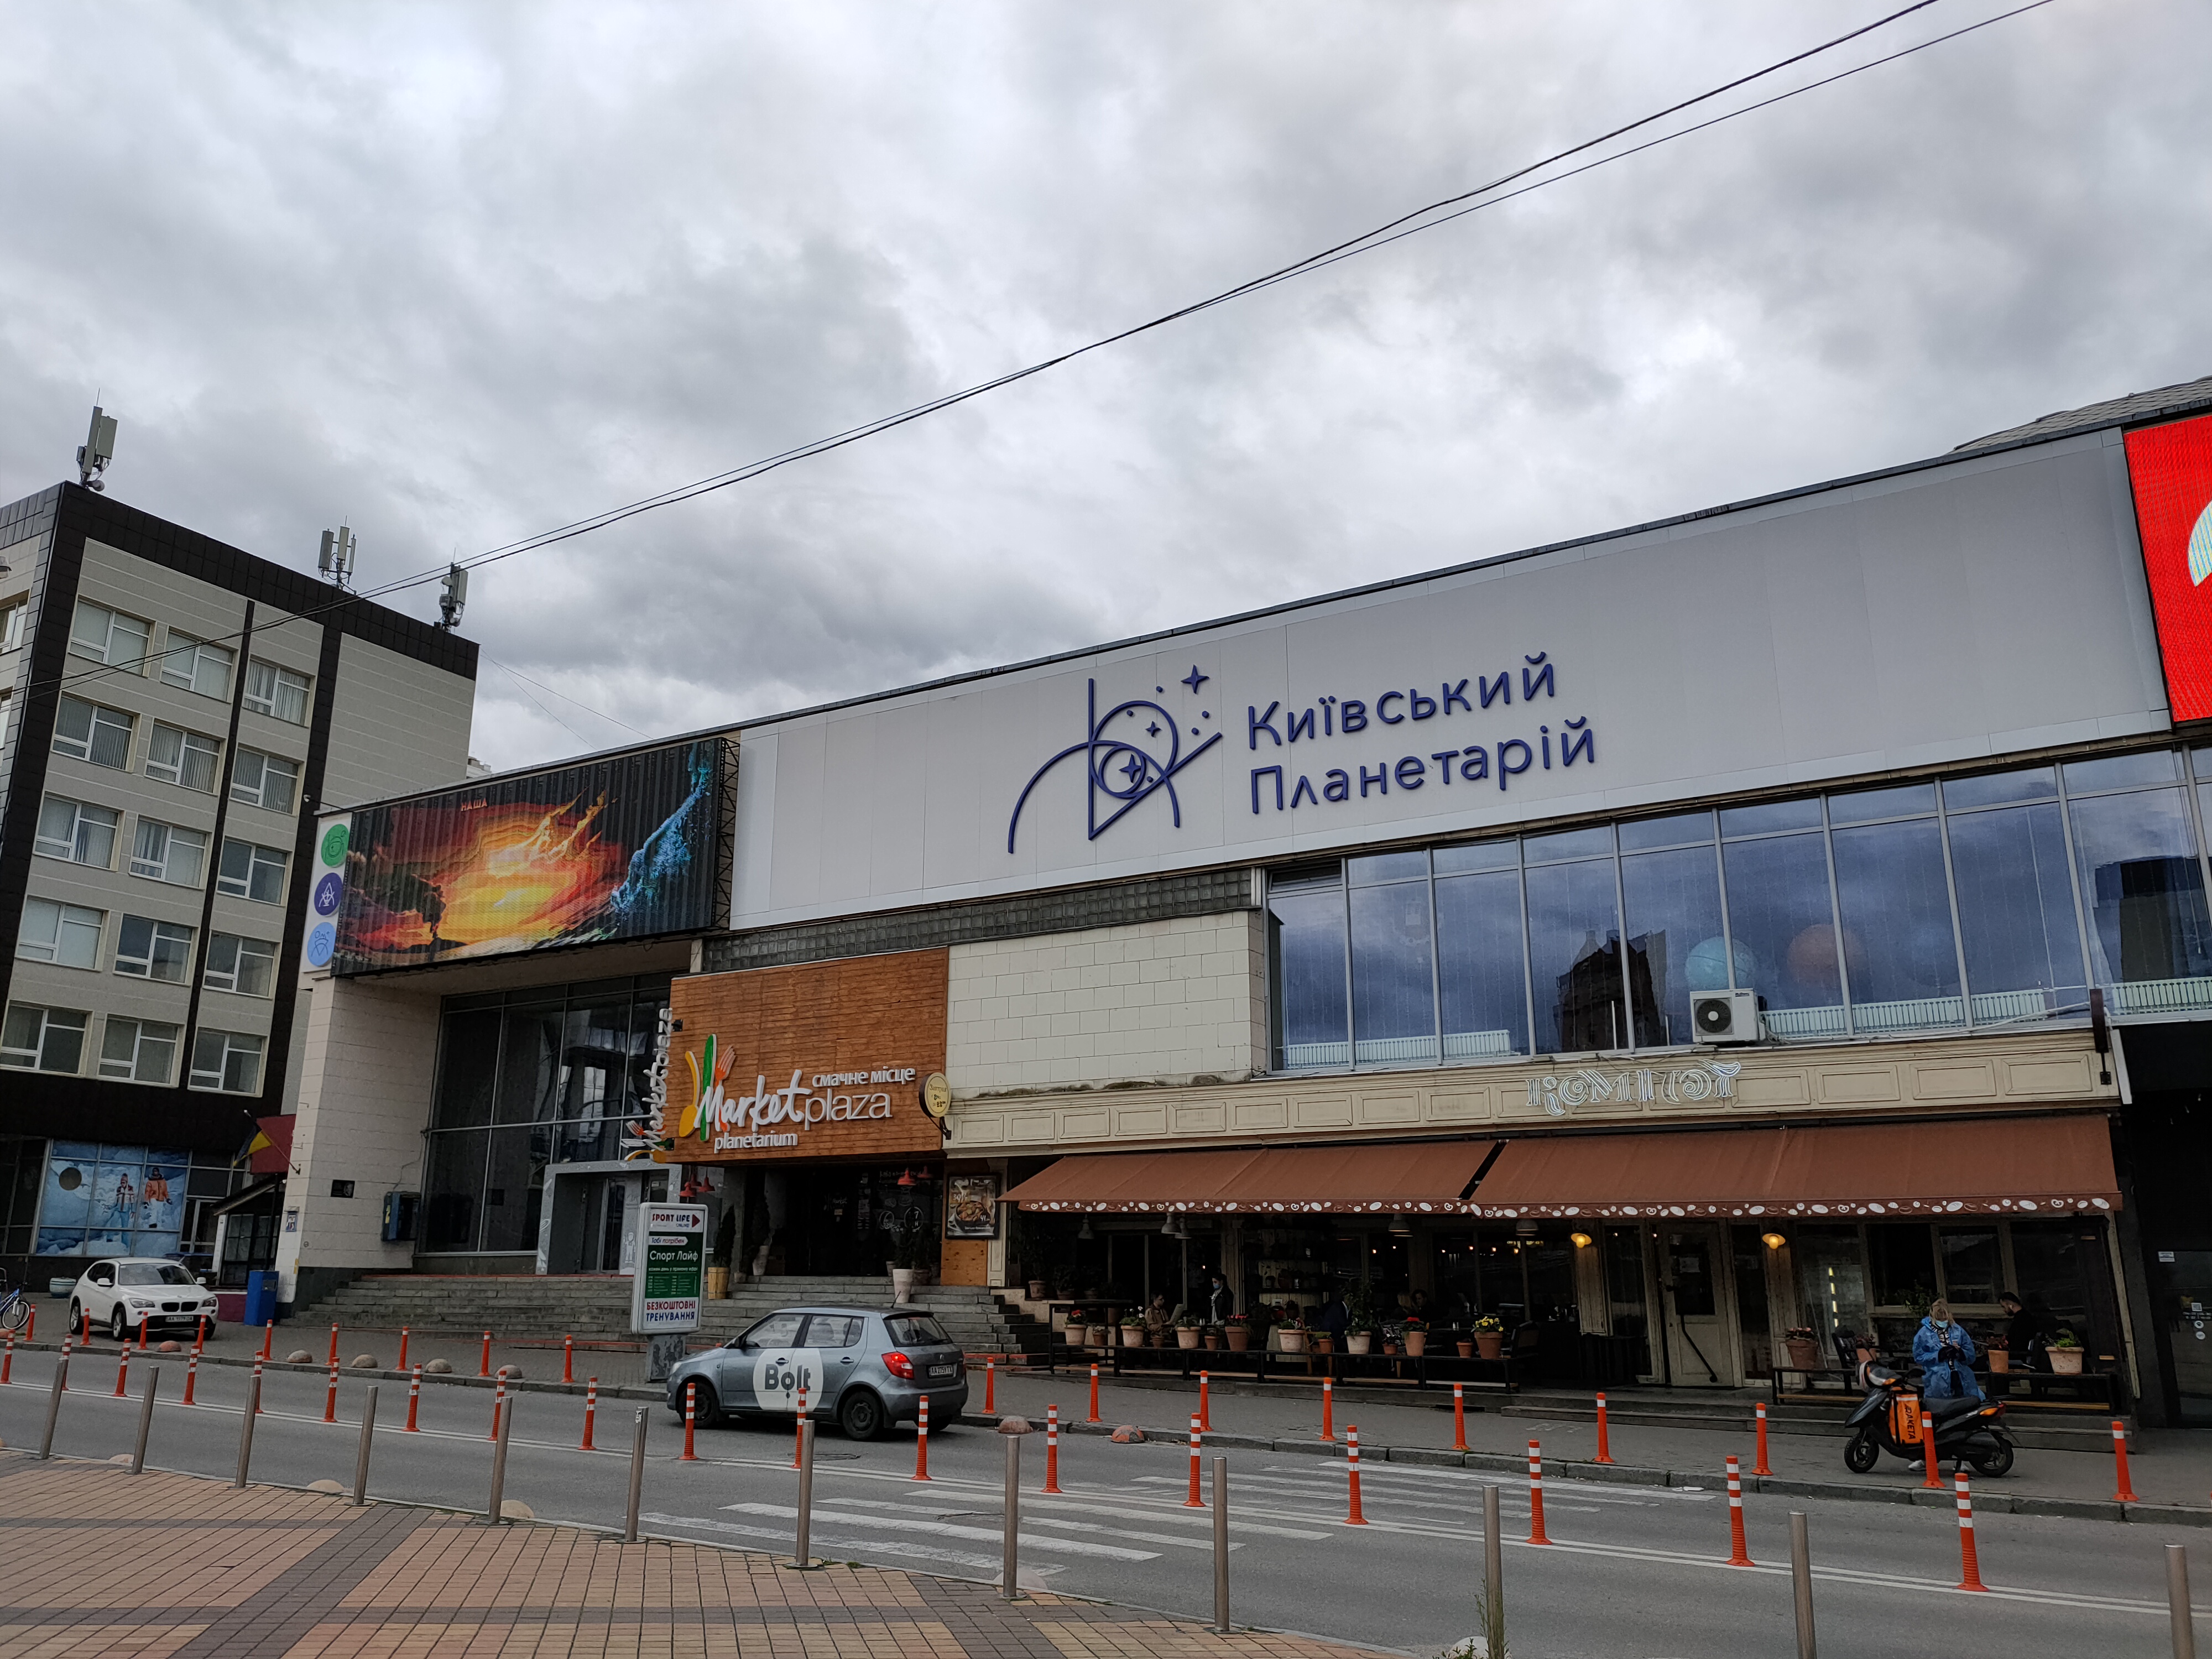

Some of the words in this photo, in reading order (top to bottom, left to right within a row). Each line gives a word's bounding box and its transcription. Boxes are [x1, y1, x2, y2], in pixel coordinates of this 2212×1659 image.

[1248, 651, 1554, 750] Київський
[1250, 716, 1595, 815] Планетарій
[461, 797, 487, 811] НАША
[812, 1070, 869, 1088] смачне
[870, 1066, 916, 1086] місце
[693, 1069, 813, 1133] Market
[805, 1088, 893, 1131] plaza
[714, 1130, 799, 1154] planetarium
[653, 1214, 675, 1222] SPORT
[649, 1250, 675, 1262] Спорт
[676, 1250, 698, 1262] Лайф
[646, 1301, 696, 1310] БЕЗКОШТОВНІ
[646, 1312, 695, 1322] ТРЕНУВАННЯ
[765, 1364, 811, 1391] Bolt
[1905, 1404, 1916, 1439] RAKETA
